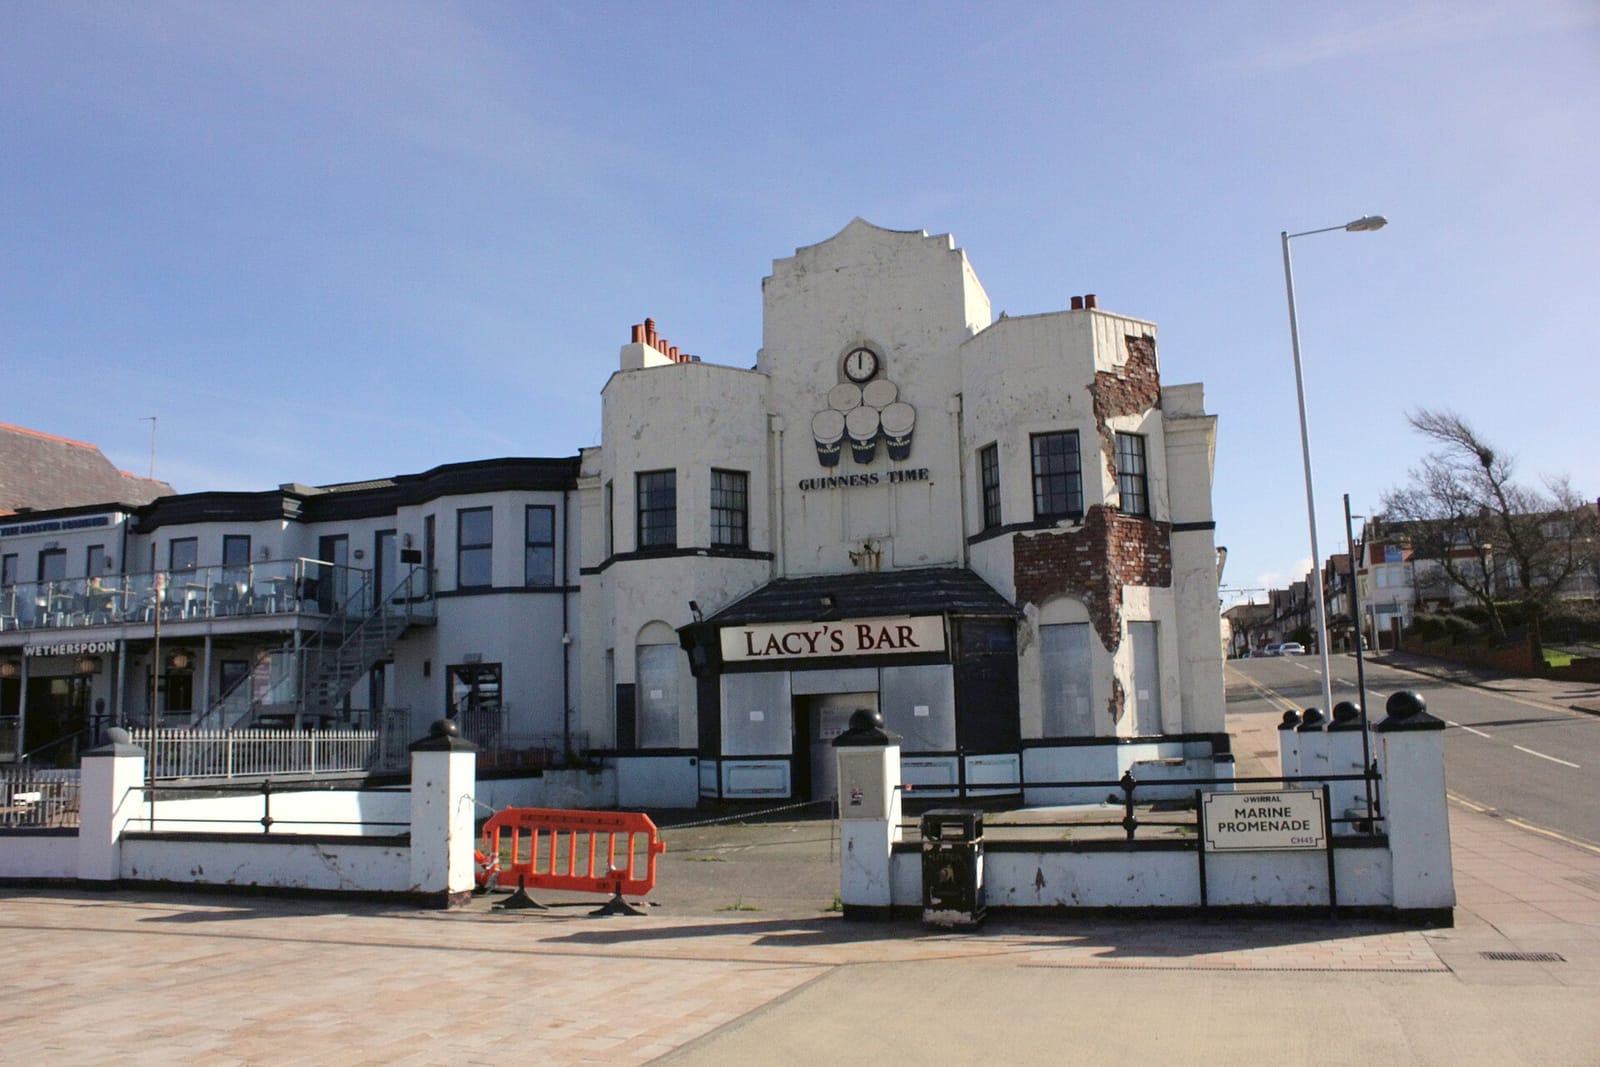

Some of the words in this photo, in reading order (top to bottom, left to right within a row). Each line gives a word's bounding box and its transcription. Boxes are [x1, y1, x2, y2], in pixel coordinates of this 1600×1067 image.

[798, 472, 879, 491] GUINNESS
[887, 468, 929, 483] TIME
[744, 626, 844, 657] LACY'S
[855, 624, 920, 650] BAR
[24, 642, 115, 656] WETHERSPOON
[1235, 807, 1292, 818] MARINE
[1218, 820, 1311, 832] PROMENADE
